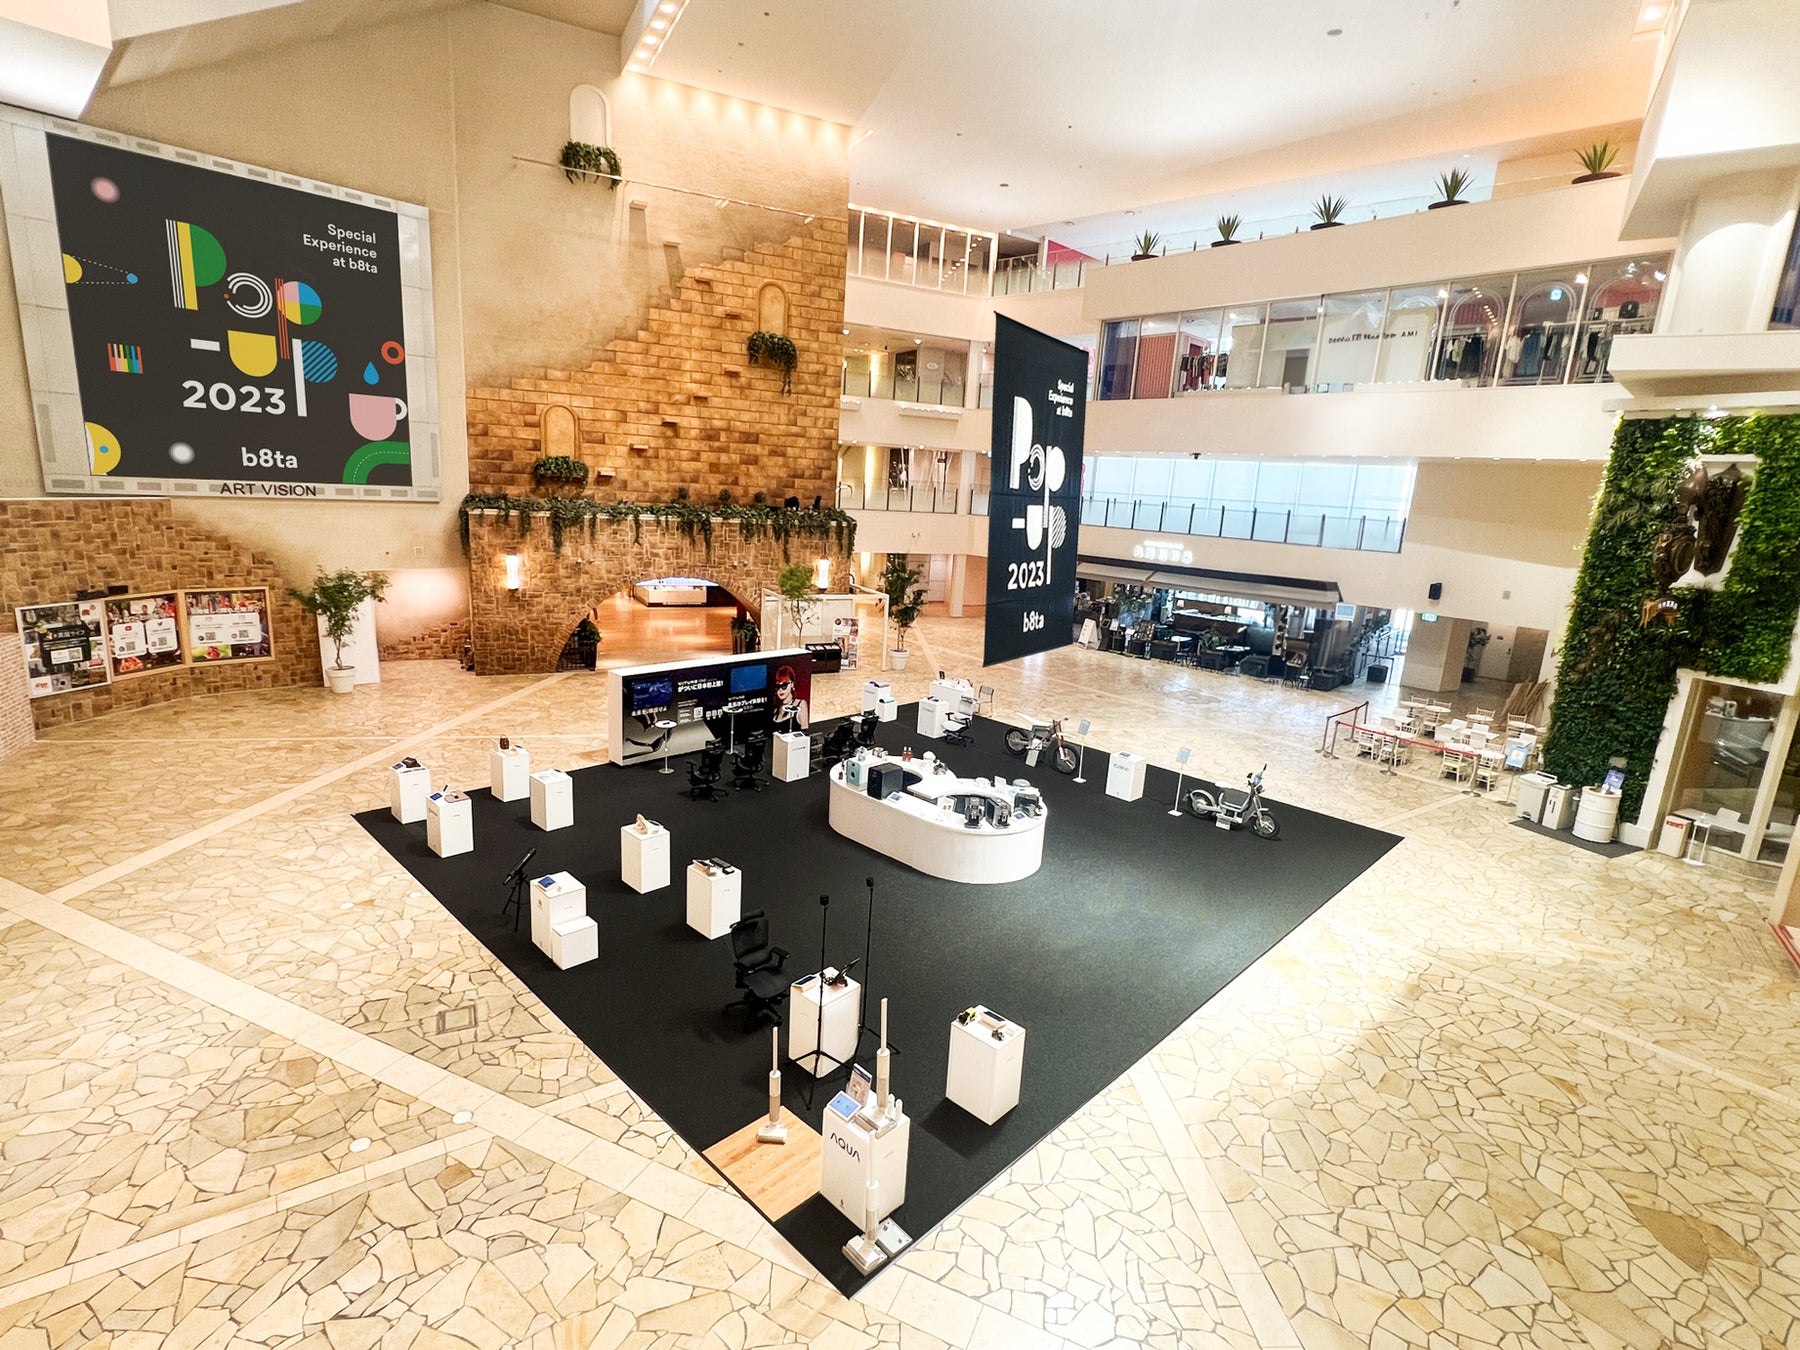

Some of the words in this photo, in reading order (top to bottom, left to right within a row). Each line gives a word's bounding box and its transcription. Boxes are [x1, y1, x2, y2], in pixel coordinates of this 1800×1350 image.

[327, 223, 377, 244] Special
[302, 233, 378, 259] Experience
[332, 255, 346, 269] at
[348, 256, 378, 274] b8ta
[181, 379, 287, 416] 2023
[240, 446, 299, 469] b8ta
[220, 482, 255, 496] ART
[260, 483, 317, 497] VISION
[1007, 560, 1045, 591] 2023
[1022, 610, 1044, 633] b8ta
[831, 1132, 860, 1162] AQUA
